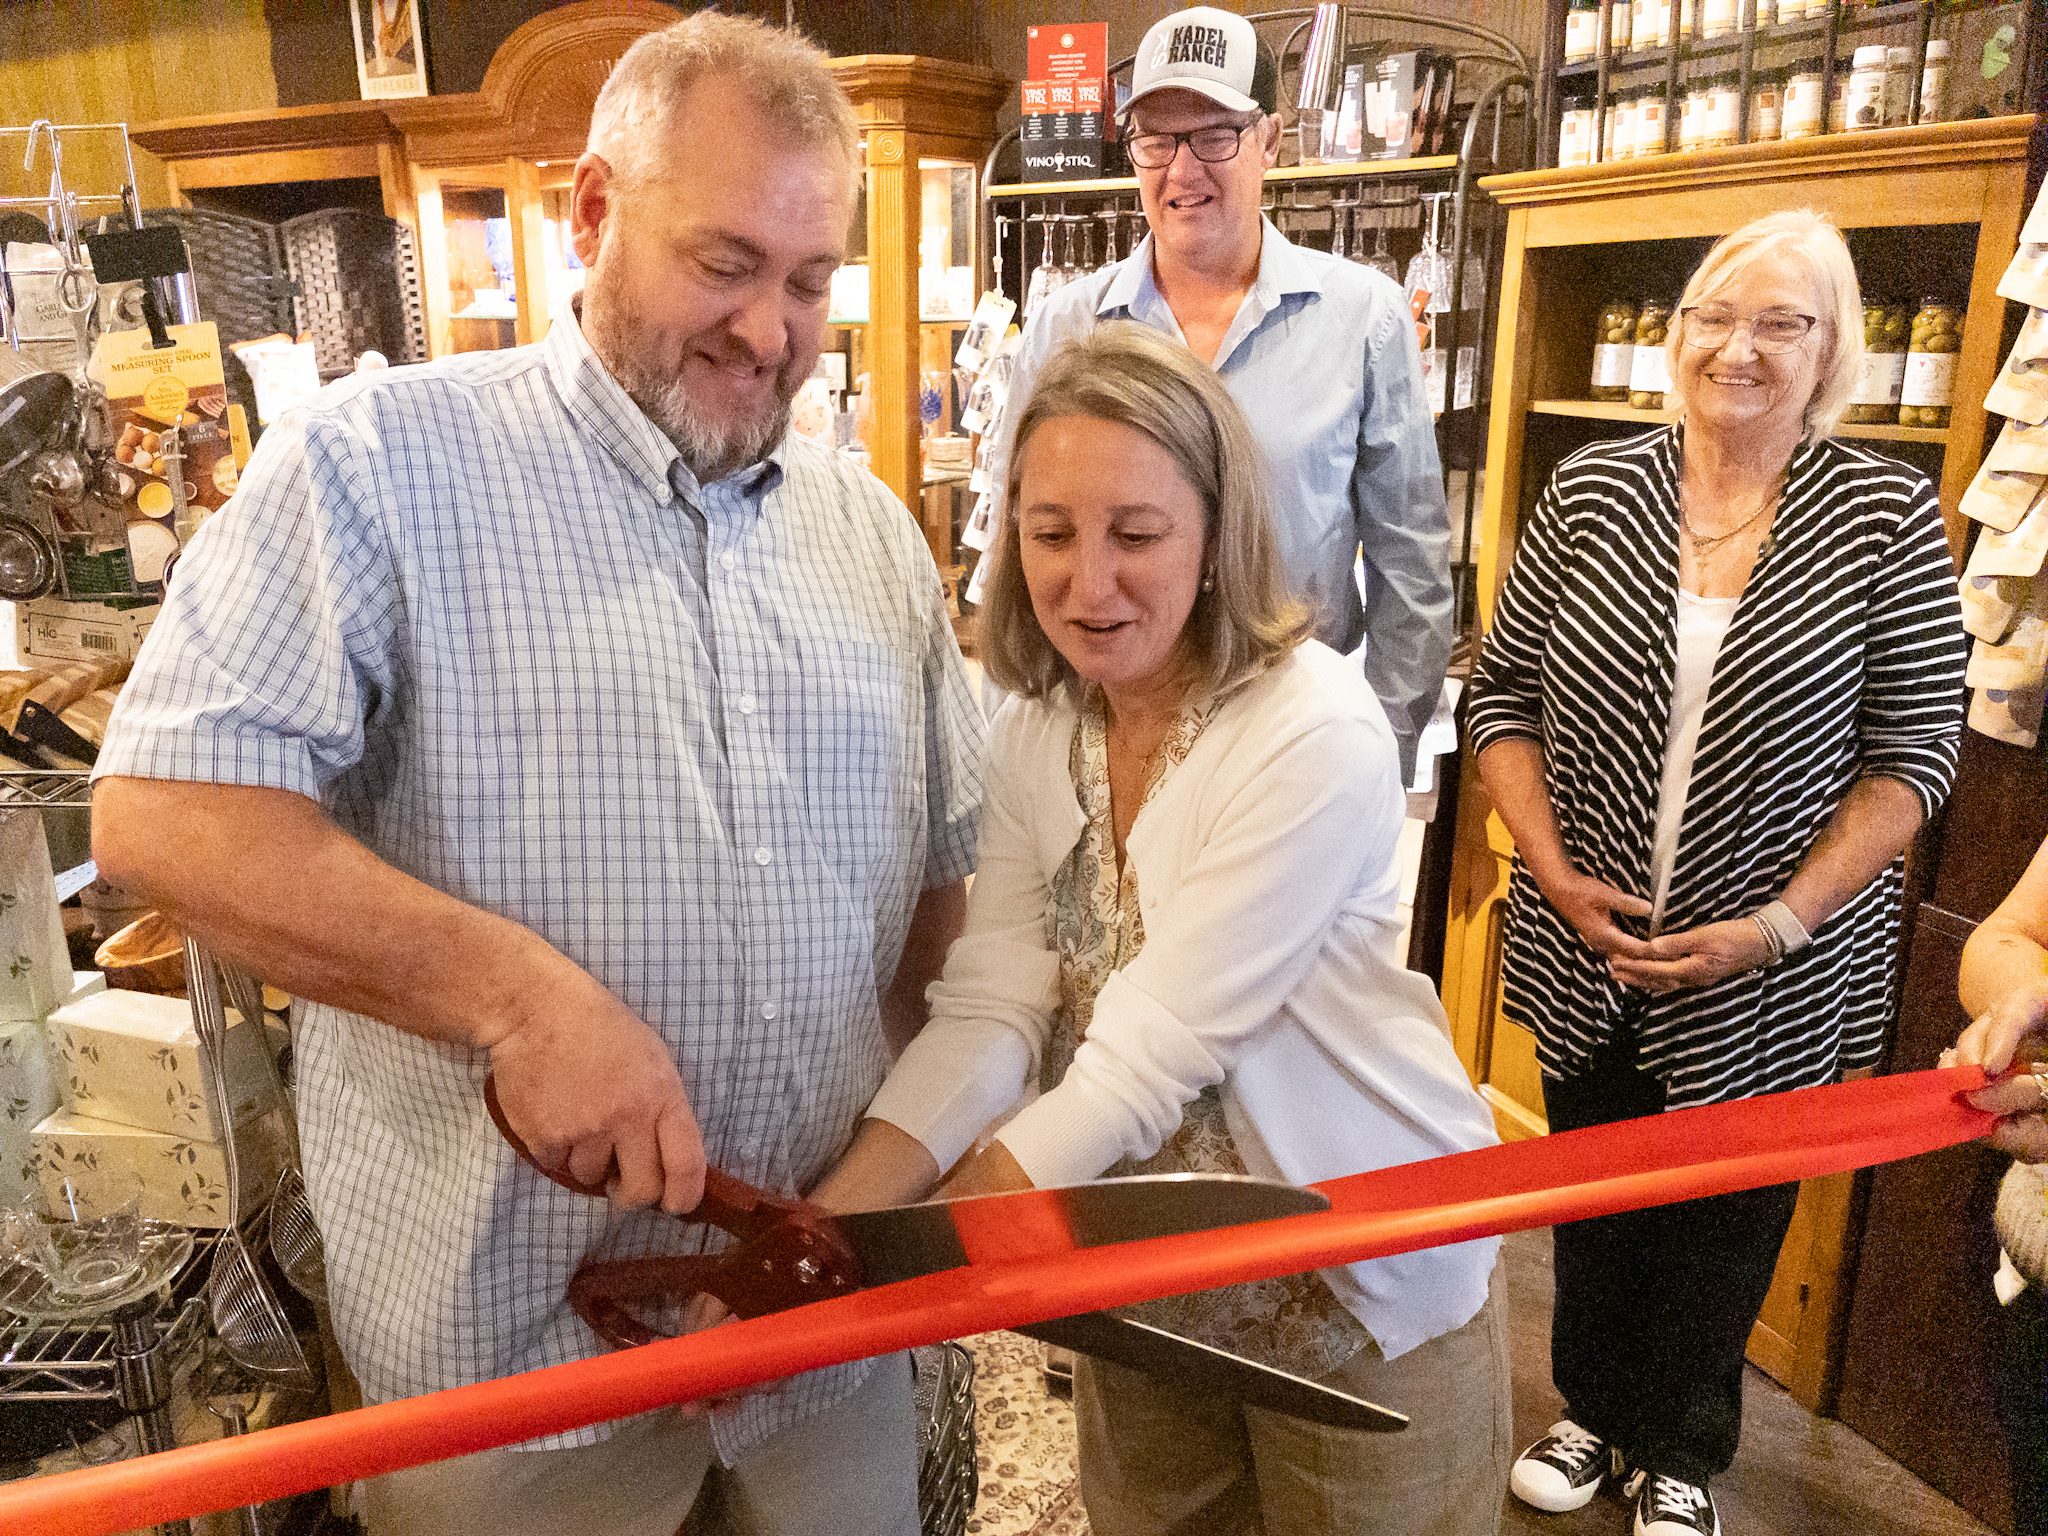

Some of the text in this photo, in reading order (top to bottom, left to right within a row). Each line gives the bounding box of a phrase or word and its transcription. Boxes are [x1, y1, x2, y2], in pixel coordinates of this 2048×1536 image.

[1172, 25, 1227, 48] KADEL
[1168, 44, 1227, 68] RANCH
[1024, 88, 1046, 97] VINO
[1051, 87, 1072, 96] VINO
[1078, 86, 1099, 95] VINO
[1026, 95, 1048, 104] STIQ
[1052, 94, 1074, 103] STIQ
[1079, 94, 1101, 102] STIQ
[1025, 156, 1054, 167] VINO
[112, 358, 173, 372] MEASURING
[176, 352, 211, 363] SPOON
[153, 365, 172, 375] SET
[198, 424, 206, 433] 6
